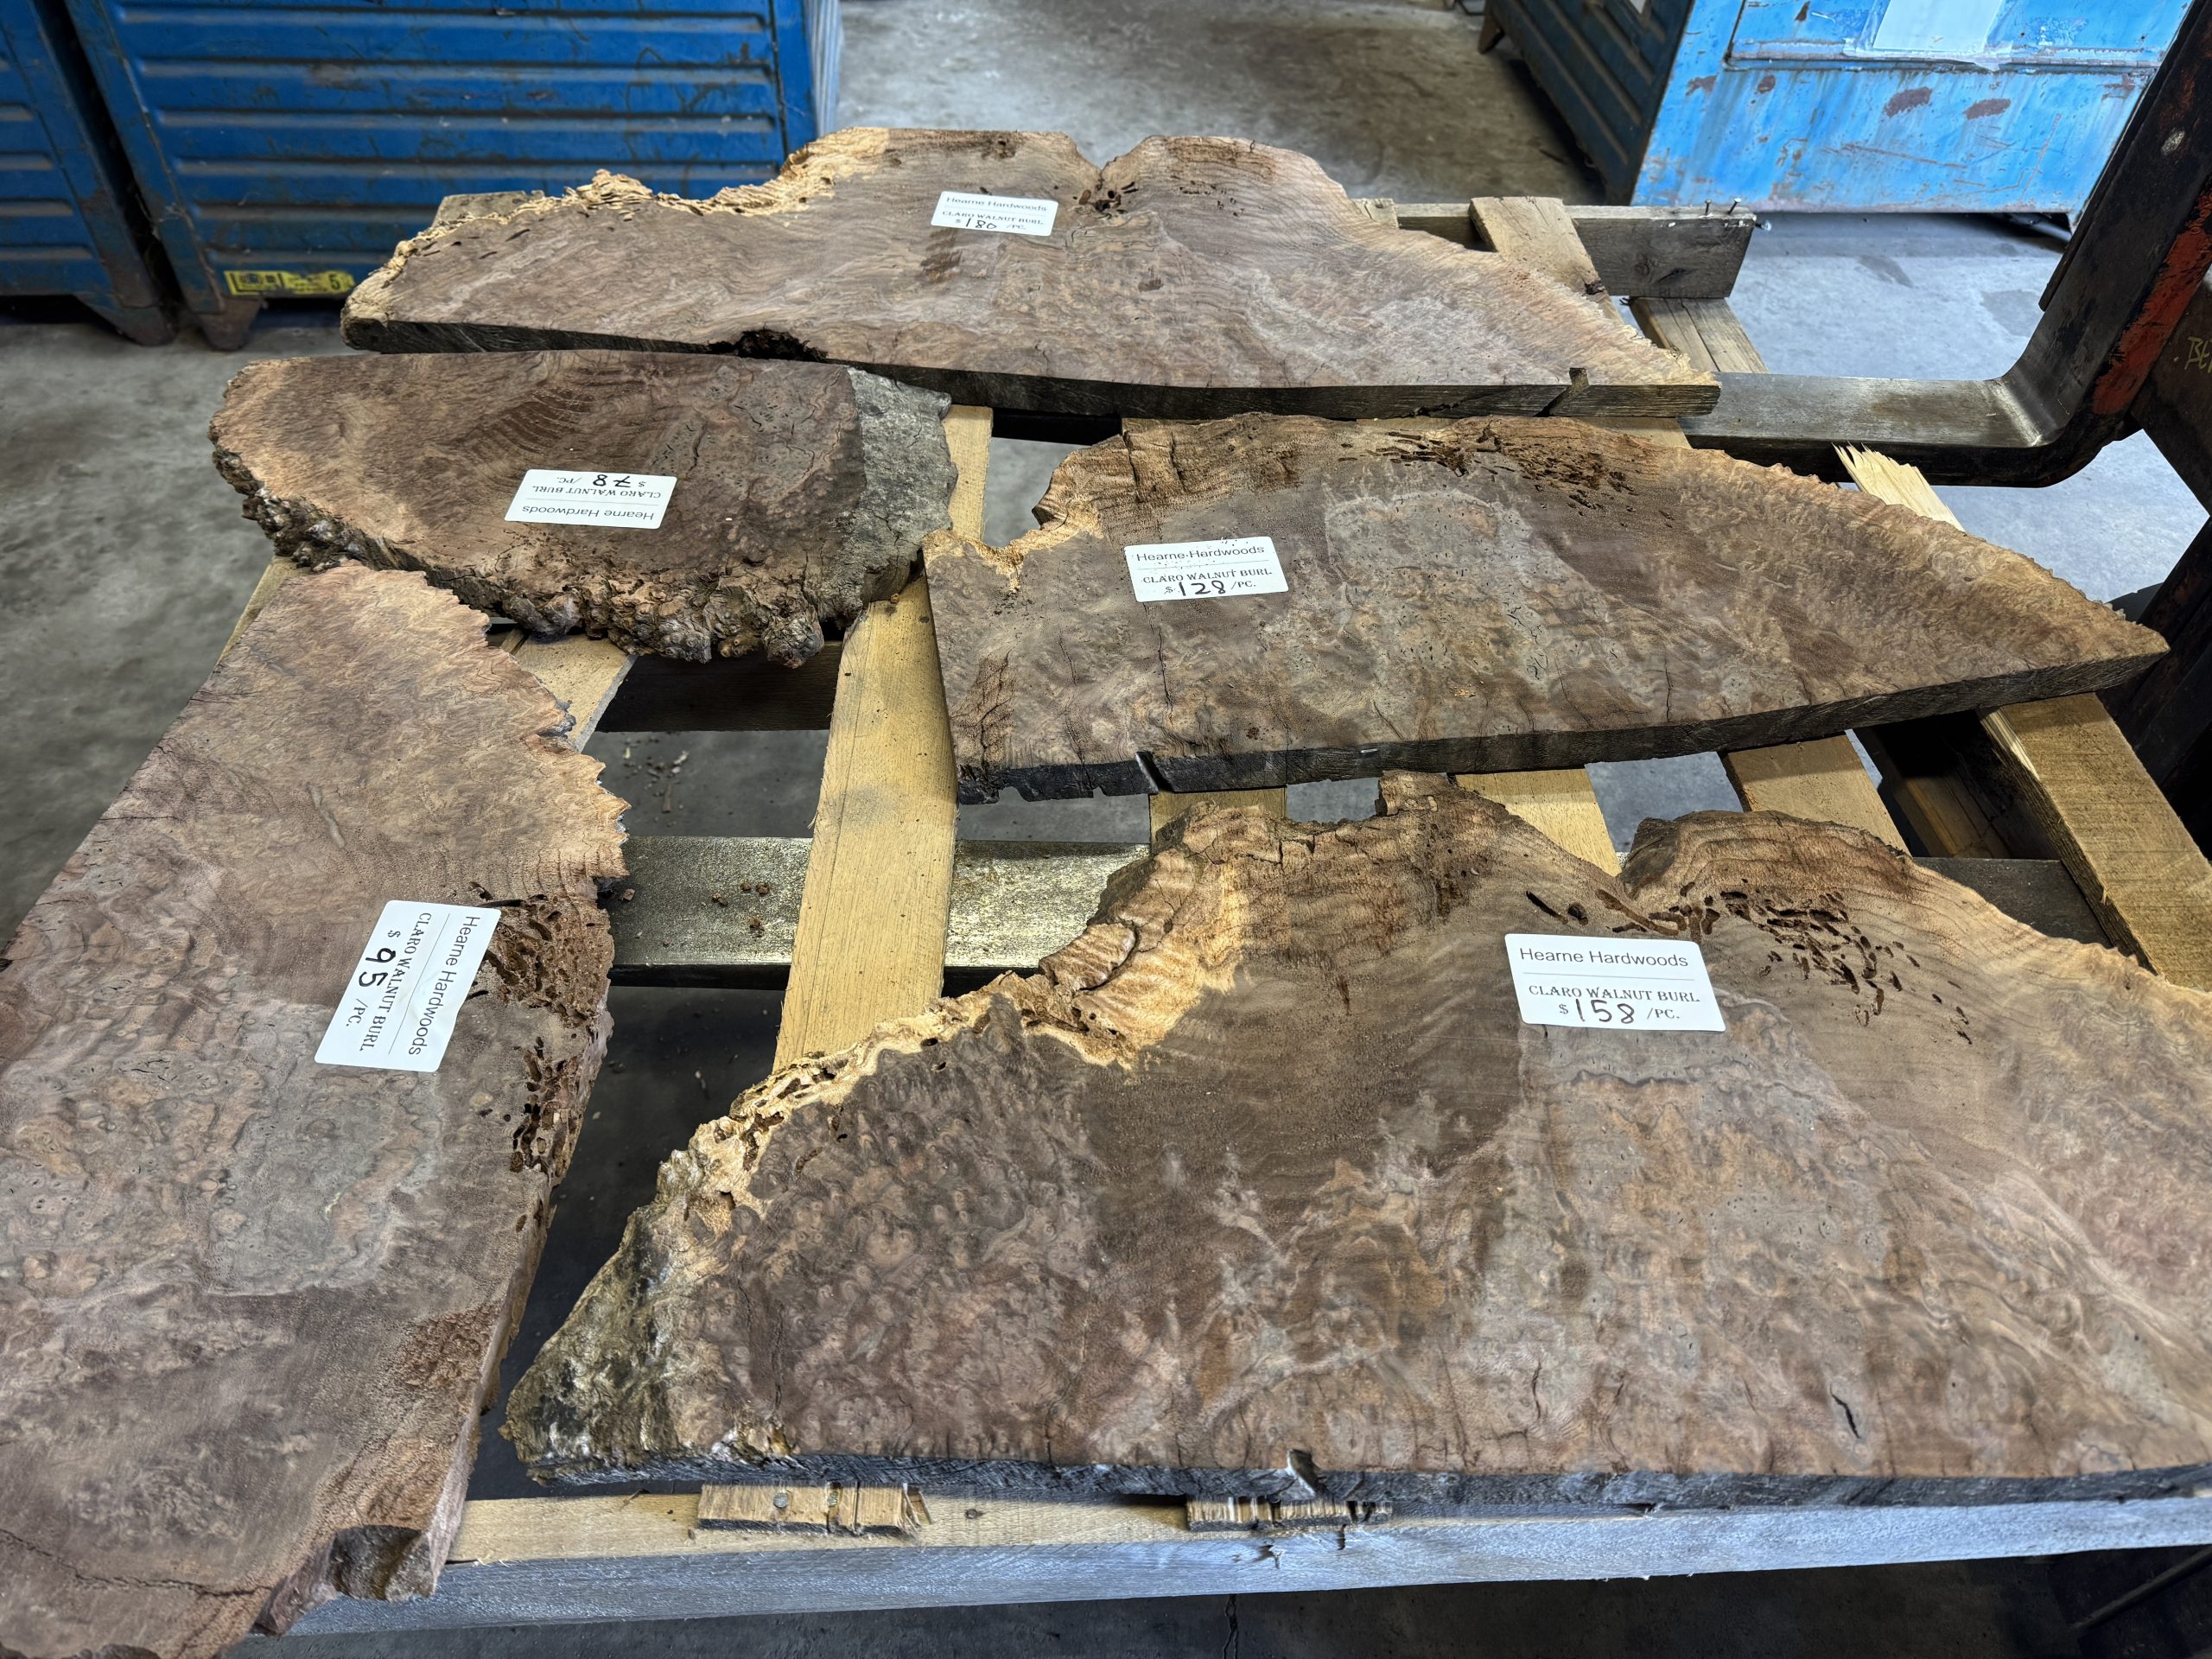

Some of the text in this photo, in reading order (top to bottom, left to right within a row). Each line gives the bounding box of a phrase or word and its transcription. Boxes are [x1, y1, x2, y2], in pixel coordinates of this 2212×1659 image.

[946, 197, 1046, 212] Hearne Hardwoods
[976, 213, 1015, 222] WALNUT
[567, 488, 616, 497] WALNUT
[523, 505, 654, 520] Hearne Hardwoods
[1137, 546, 1265, 561] Hearne Hardwoods
[1143, 568, 1272, 583] CLARO WALNUT BURL
[1231, 581, 1255, 589] /PC.
[1520, 948, 1688, 967] Hearne Hardwoods
[359, 912, 431, 1052] CLARO WALNUT BURL
[409, 916, 480, 1055] Hearne Hardwoods
[1529, 985, 1700, 1001] CLARO WALNUT BURL
[346, 998, 368, 1027] /PC.
[1647, 1007, 1680, 1020] /PC.
